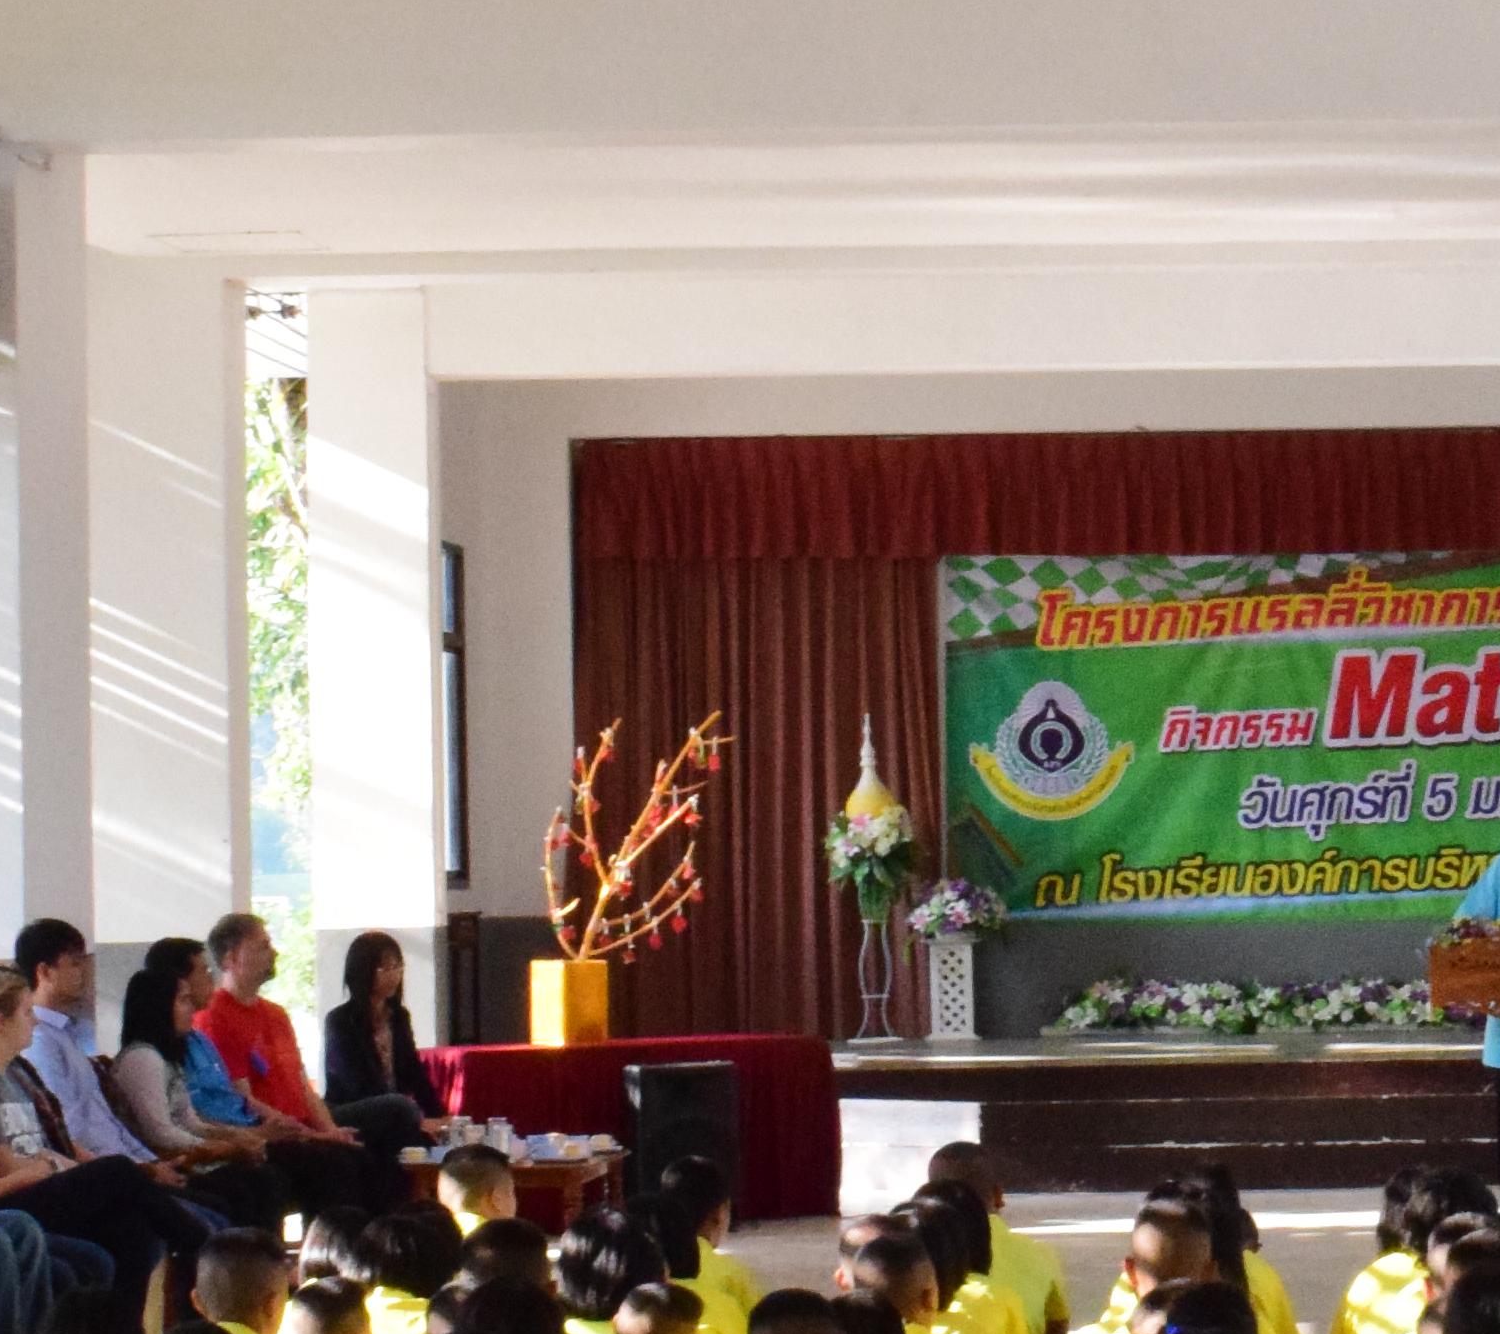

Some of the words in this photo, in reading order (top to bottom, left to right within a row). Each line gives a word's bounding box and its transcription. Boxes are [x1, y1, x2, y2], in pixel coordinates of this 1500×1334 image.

[1162, 707, 1314, 750] กิจกรรม
[1426, 777, 1456, 817] 5
[1036, 873, 1078, 907] ณ
